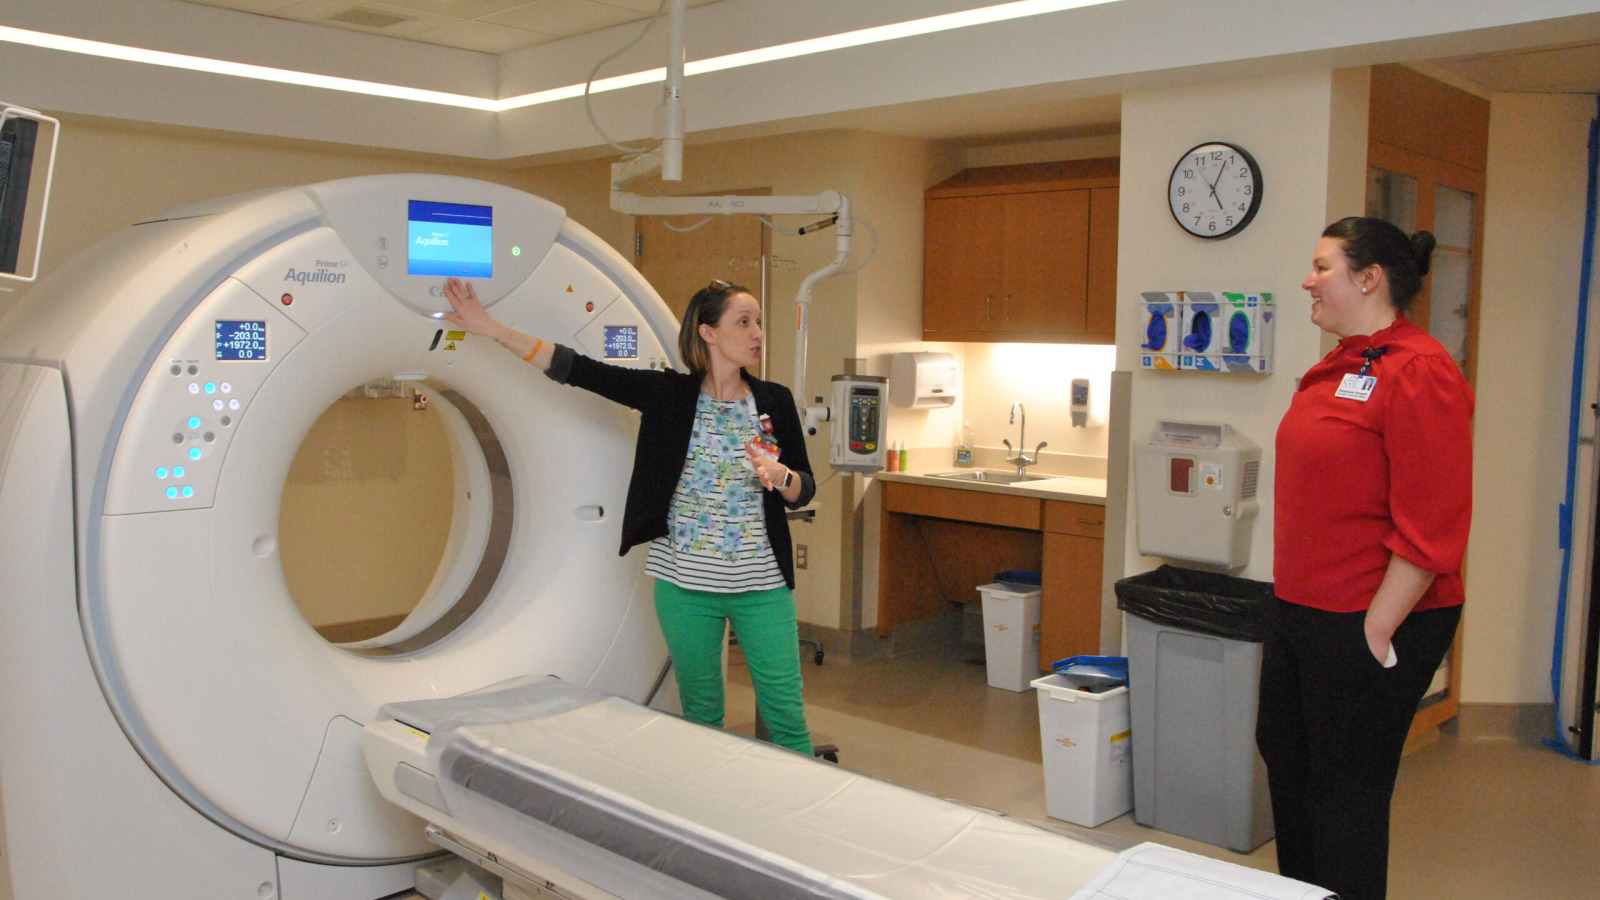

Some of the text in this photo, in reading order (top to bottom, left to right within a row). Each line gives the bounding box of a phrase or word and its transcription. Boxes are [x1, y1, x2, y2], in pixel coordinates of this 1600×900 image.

[1210, 151, 1222, 160] 12
[1230, 155, 1234, 165] 1
[1195, 156, 1205, 166] 11
[1183, 169, 1193, 179] 10
[1240, 168, 1248, 178] 2
[1178, 187, 1185, 196] 9
[1244, 185, 1252, 195] 3
[1182, 203, 1190, 213] 8
[1238, 203, 1246, 212] 4
[1194, 216, 1201, 226] 7
[1208, 221, 1216, 231] 6
[1225, 216, 1233, 226] 5
[316, 260, 339, 268] Prime
[284, 268, 346, 286] Aquilion
[239, 322, 258, 331] +0.0
[223, 341, 258, 349] +1972.0
[238, 350, 253, 358] 0.0
